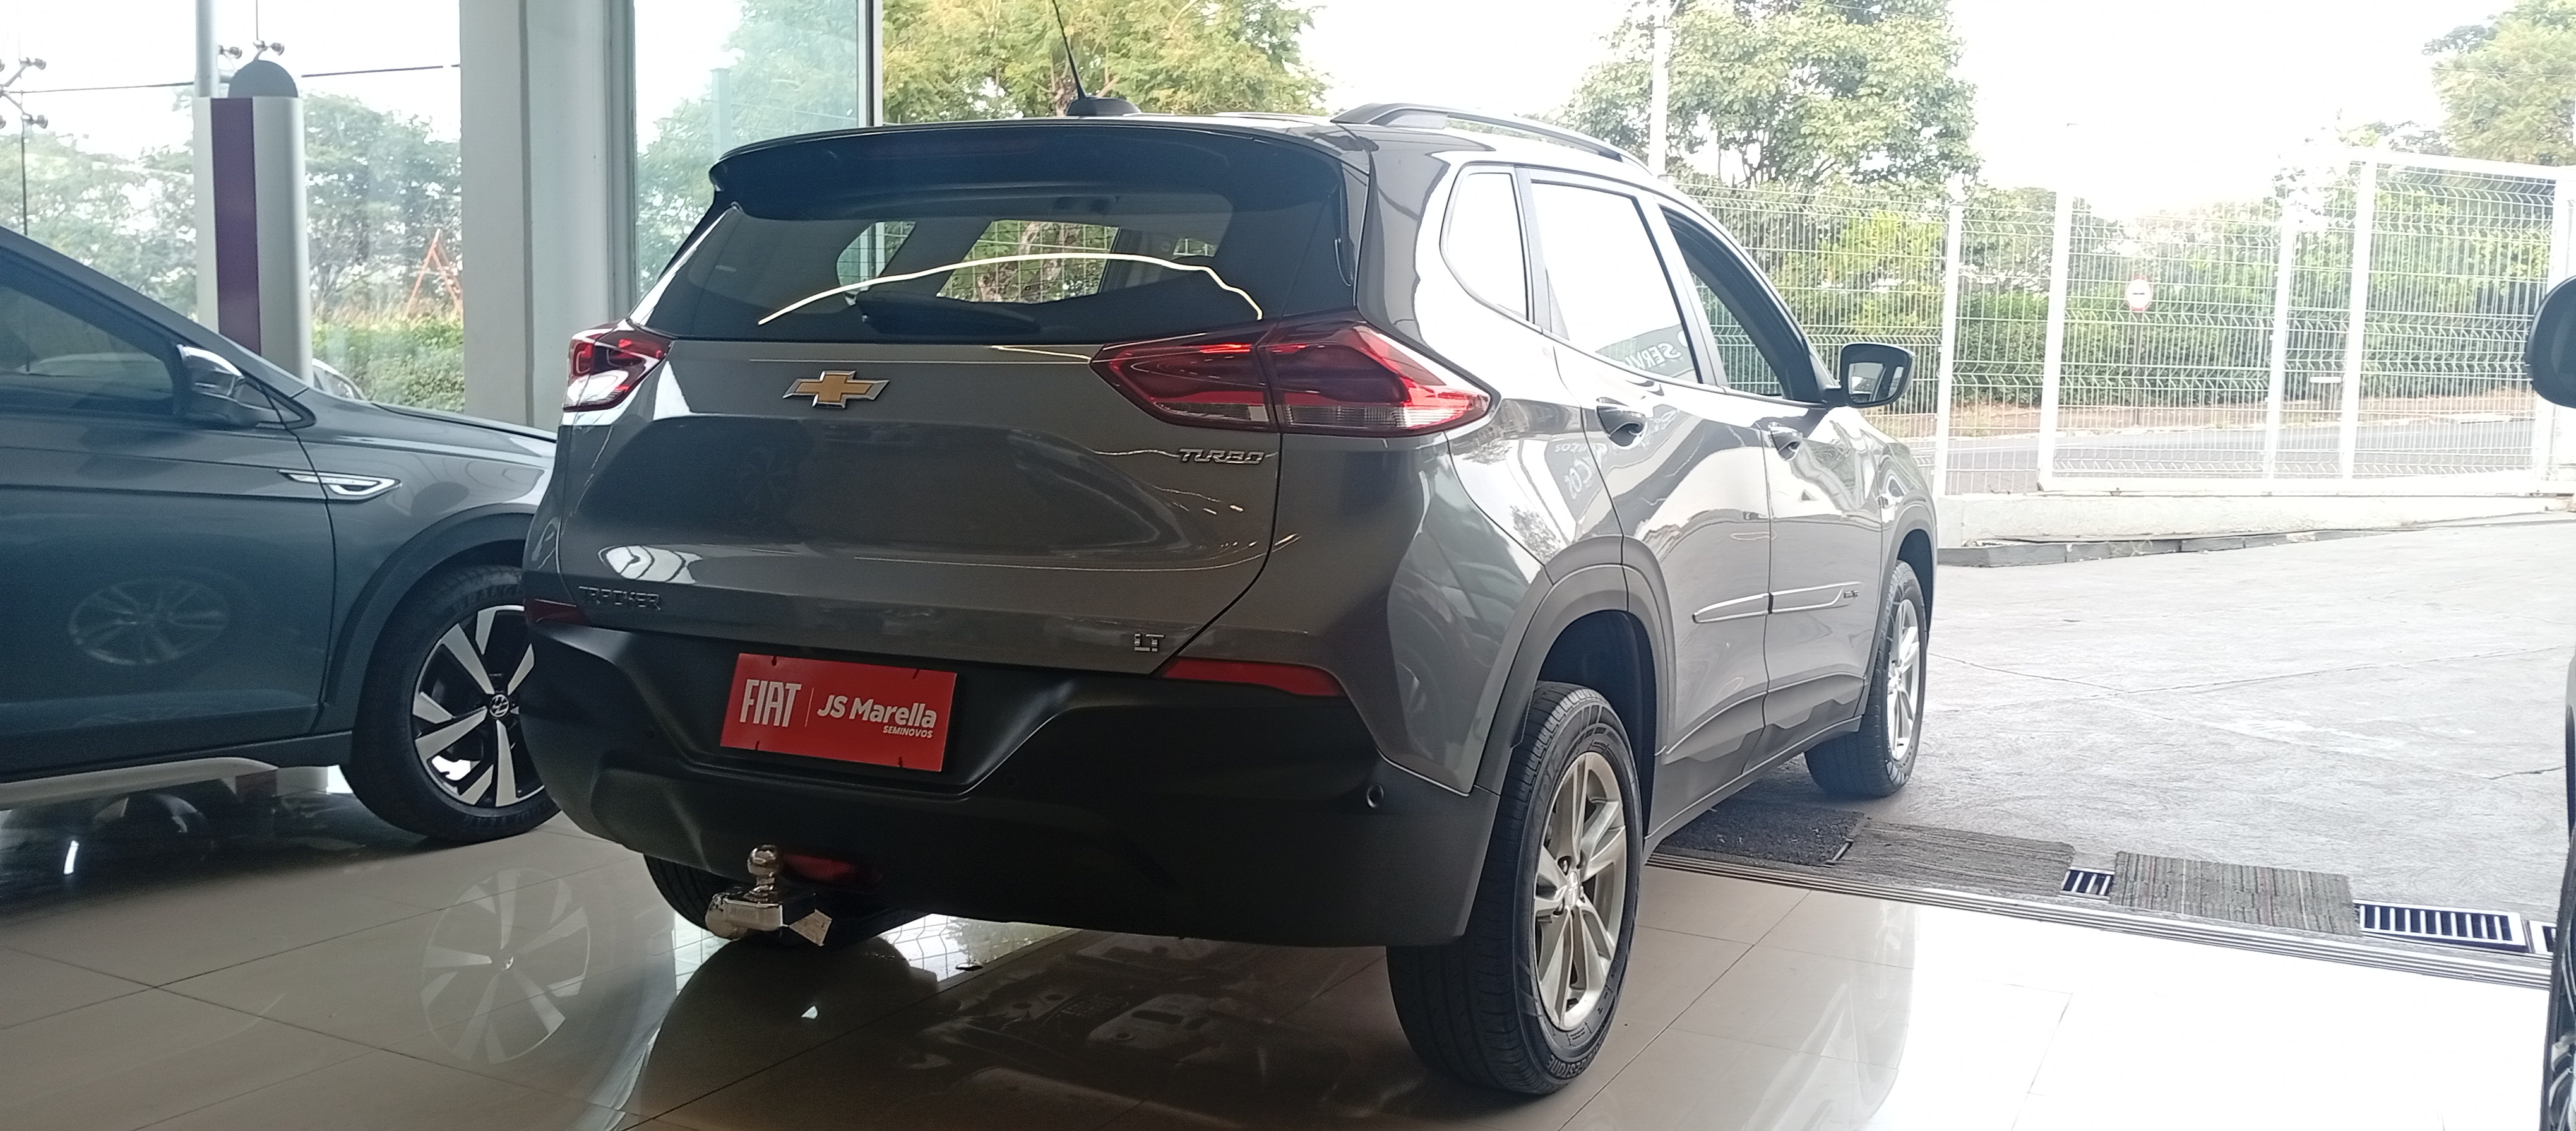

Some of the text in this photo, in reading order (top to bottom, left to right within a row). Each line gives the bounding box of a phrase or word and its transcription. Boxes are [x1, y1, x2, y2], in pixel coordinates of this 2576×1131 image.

[1179, 448, 1265, 465] TURBO
[1134, 633, 1164, 652] LT
[739, 678, 802, 728] FIAT
[817, 694, 937, 729] JS Marella
[883, 725, 933, 738] SEMINOVOS
[1546, 1038, 1604, 1078] IDGESTONE
